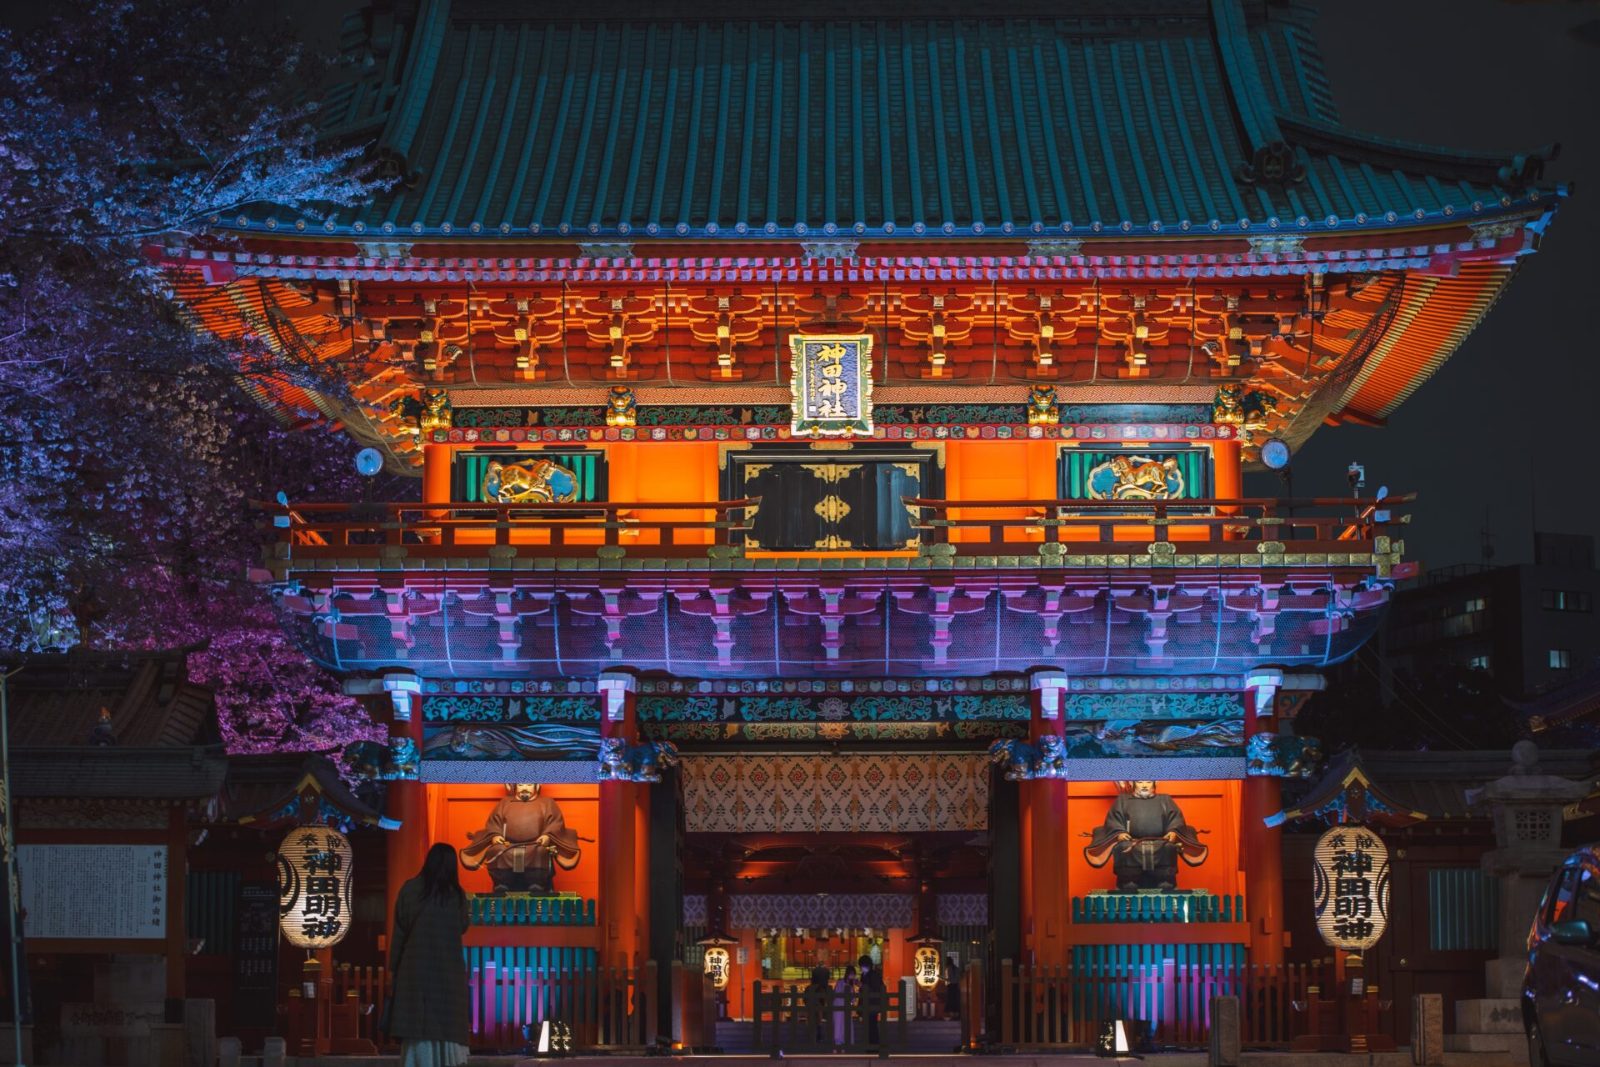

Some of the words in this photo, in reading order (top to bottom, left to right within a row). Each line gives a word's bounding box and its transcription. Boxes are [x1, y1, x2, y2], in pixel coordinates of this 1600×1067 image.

[817, 343, 847, 418] 神田神社
[302, 848, 342, 939] 神田明神
[1331, 849, 1375, 940] 神田明神
